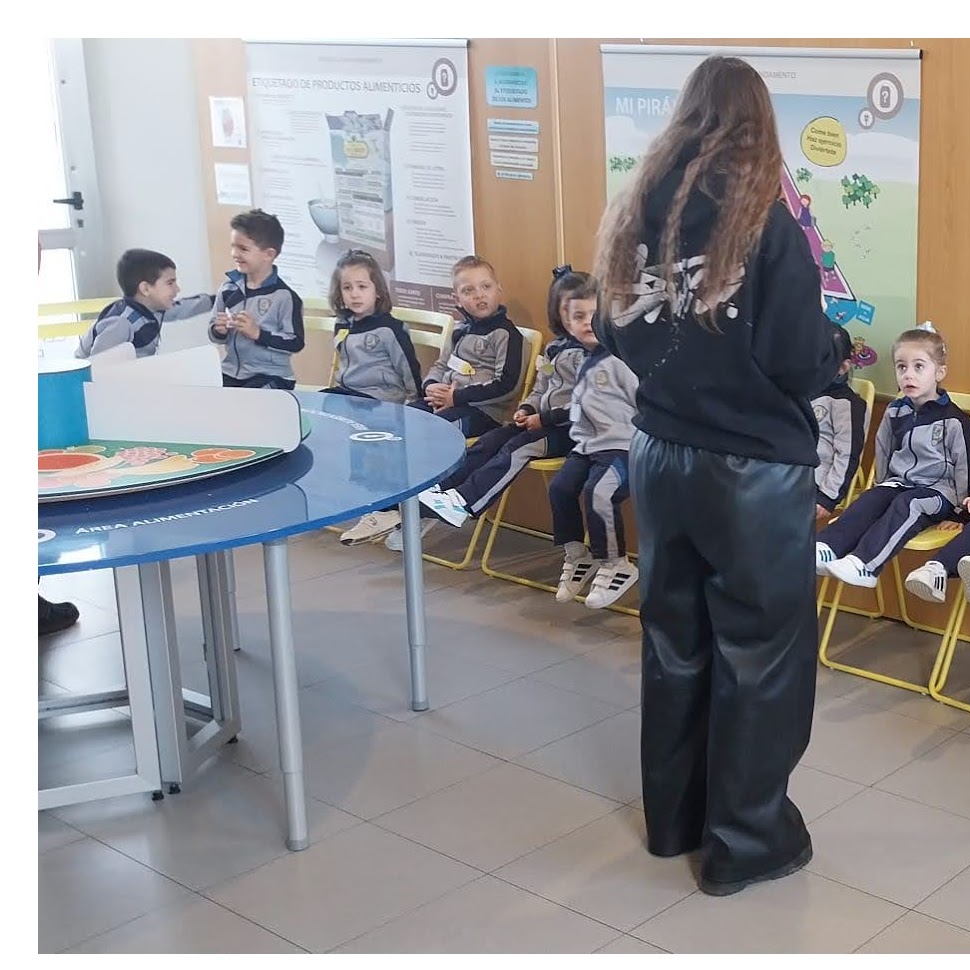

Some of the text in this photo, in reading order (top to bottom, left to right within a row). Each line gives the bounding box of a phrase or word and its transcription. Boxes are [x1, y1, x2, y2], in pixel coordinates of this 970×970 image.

[252, 78, 421, 94] ETIQUETADO DE PRODUCTOS ALIMENTICIOS
[616, 95, 675, 117] MI PIRÁ
[75, 498, 260, 535] ÁREA ALIMENTACIÓN
